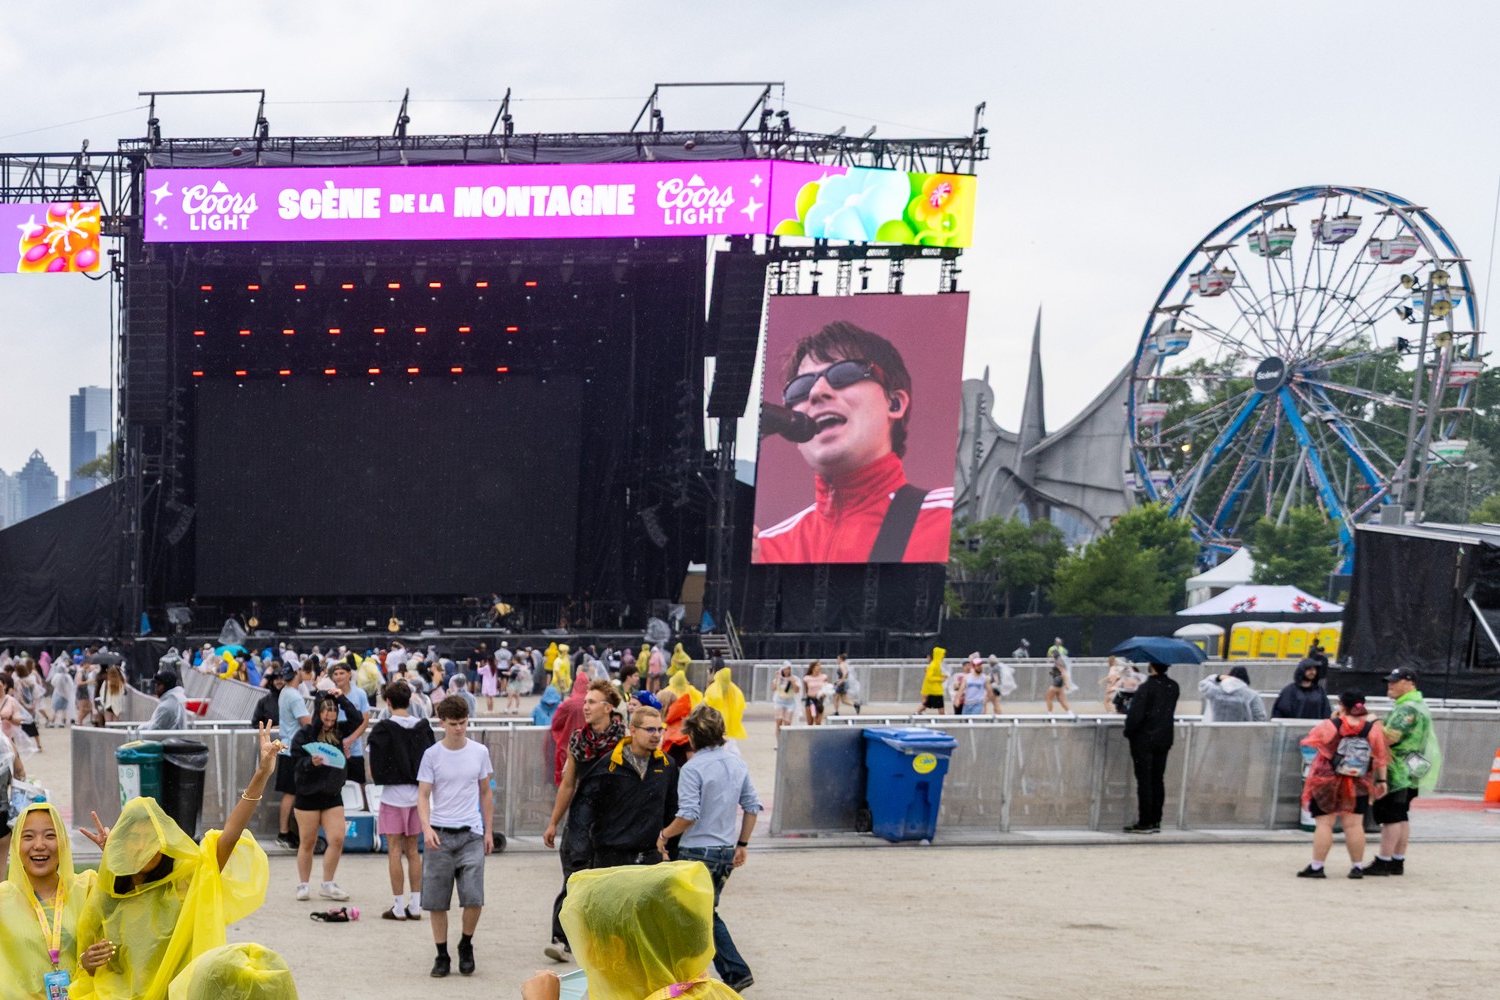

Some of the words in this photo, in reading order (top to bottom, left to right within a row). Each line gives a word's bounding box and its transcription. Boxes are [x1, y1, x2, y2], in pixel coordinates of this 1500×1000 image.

[181, 183, 259, 215] Coors
[278, 180, 382, 220] SCÈNE
[389, 193, 416, 214] DE
[418, 193, 446, 213] LA
[453, 184, 636, 218] MONTAGNE
[656, 177, 736, 209] Coors
[189, 213, 250, 231] LIGHT
[664, 207, 727, 225] LIGHT
